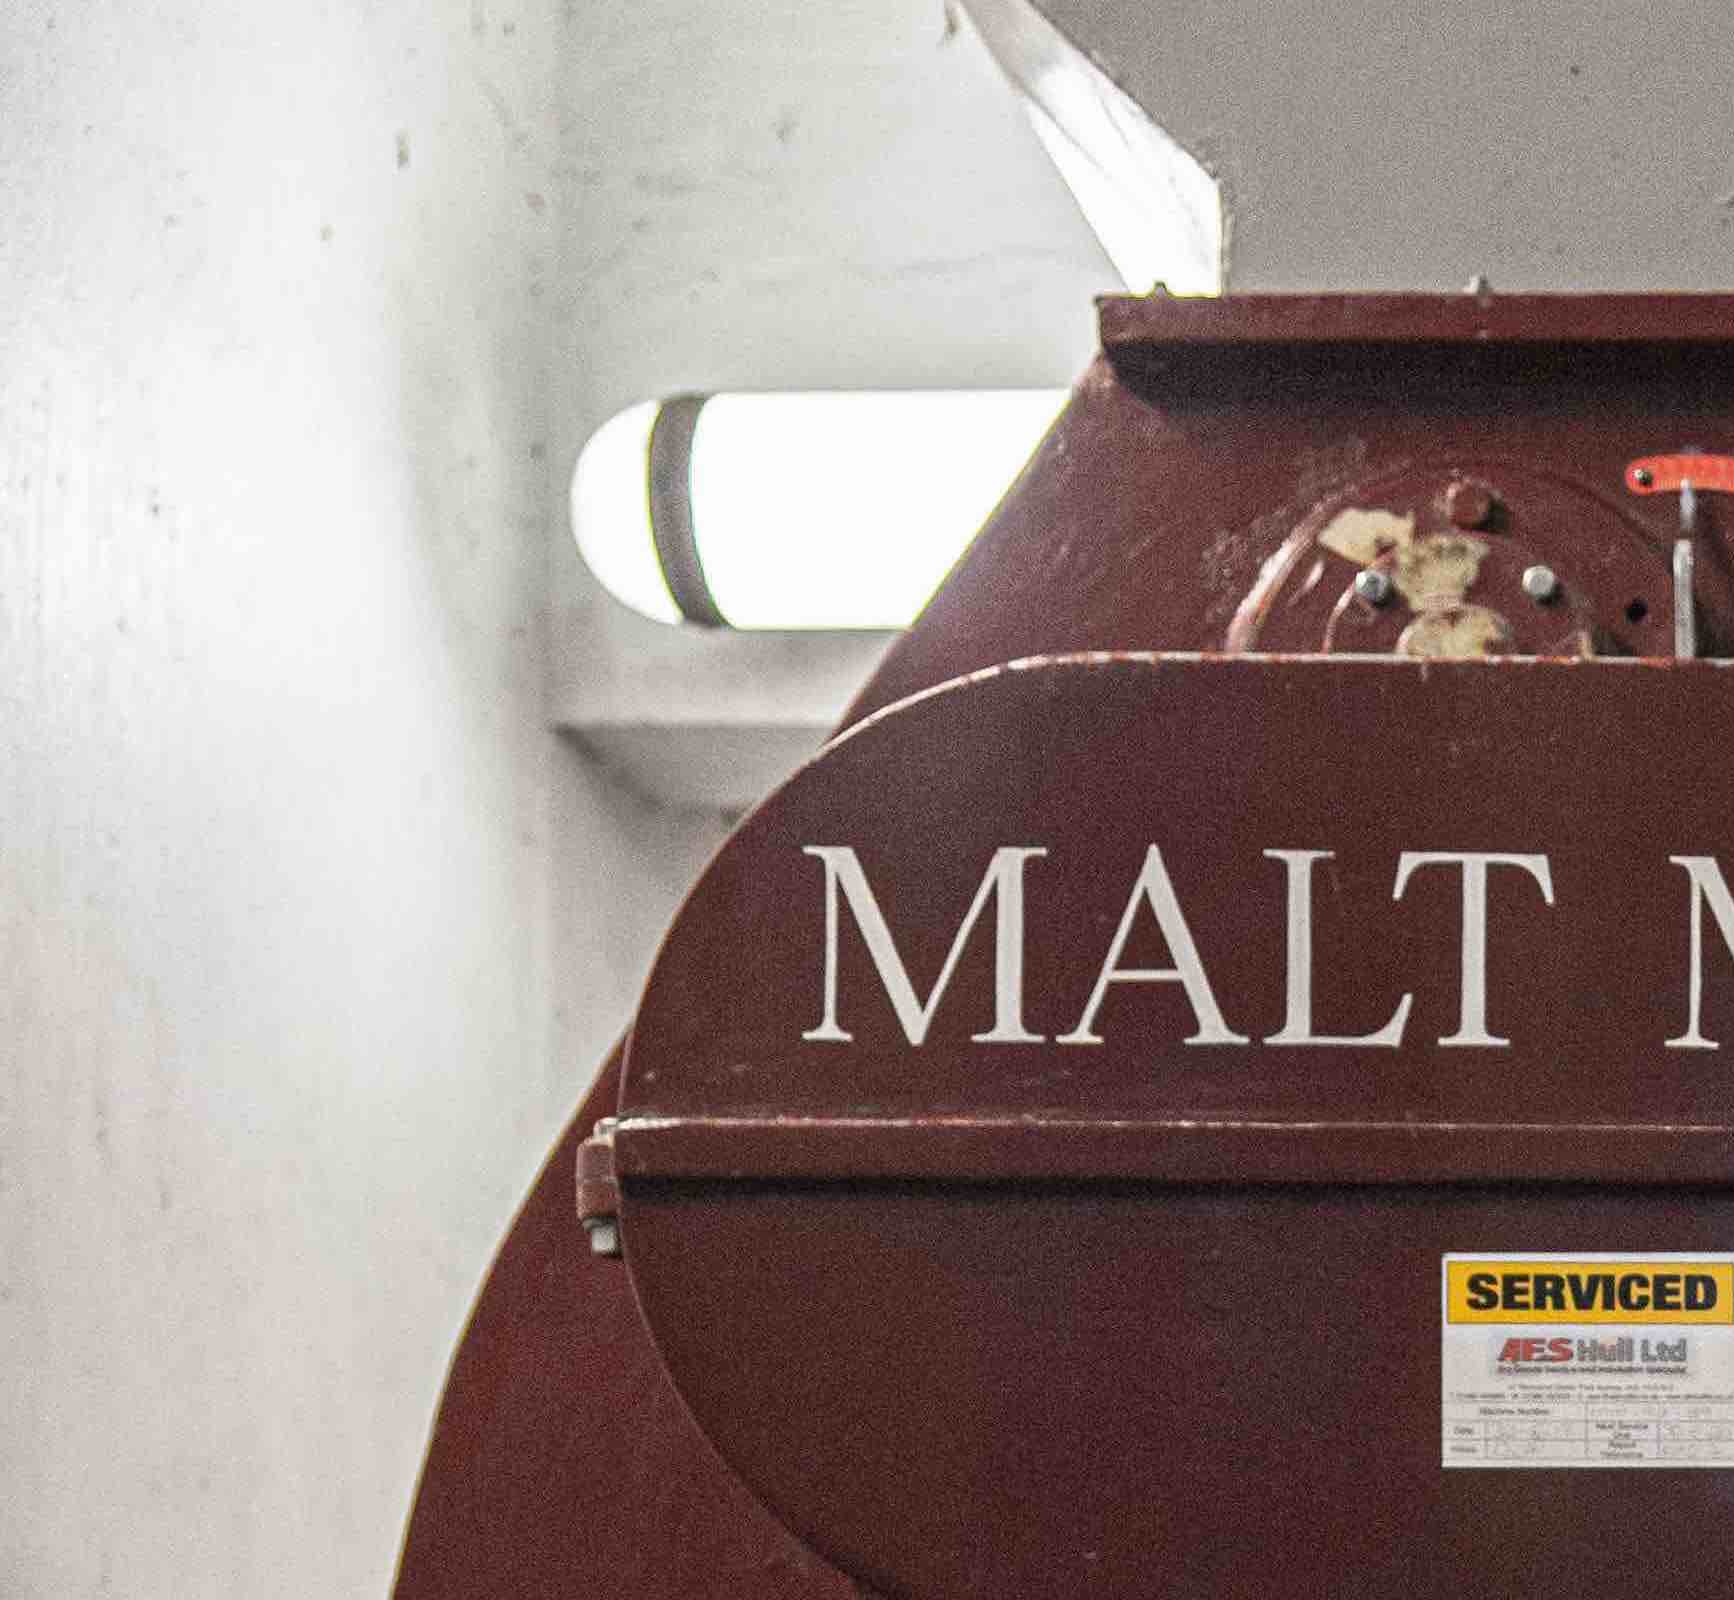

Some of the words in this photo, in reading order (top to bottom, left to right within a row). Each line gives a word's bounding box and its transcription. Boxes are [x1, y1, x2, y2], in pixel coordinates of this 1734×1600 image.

[803, 844, 1554, 1046] MALT
[1466, 1273, 1717, 1311] SERVICED
[1577, 1337, 1633, 1363] Hull
[1640, 1338, 1688, 1363] Ltd
